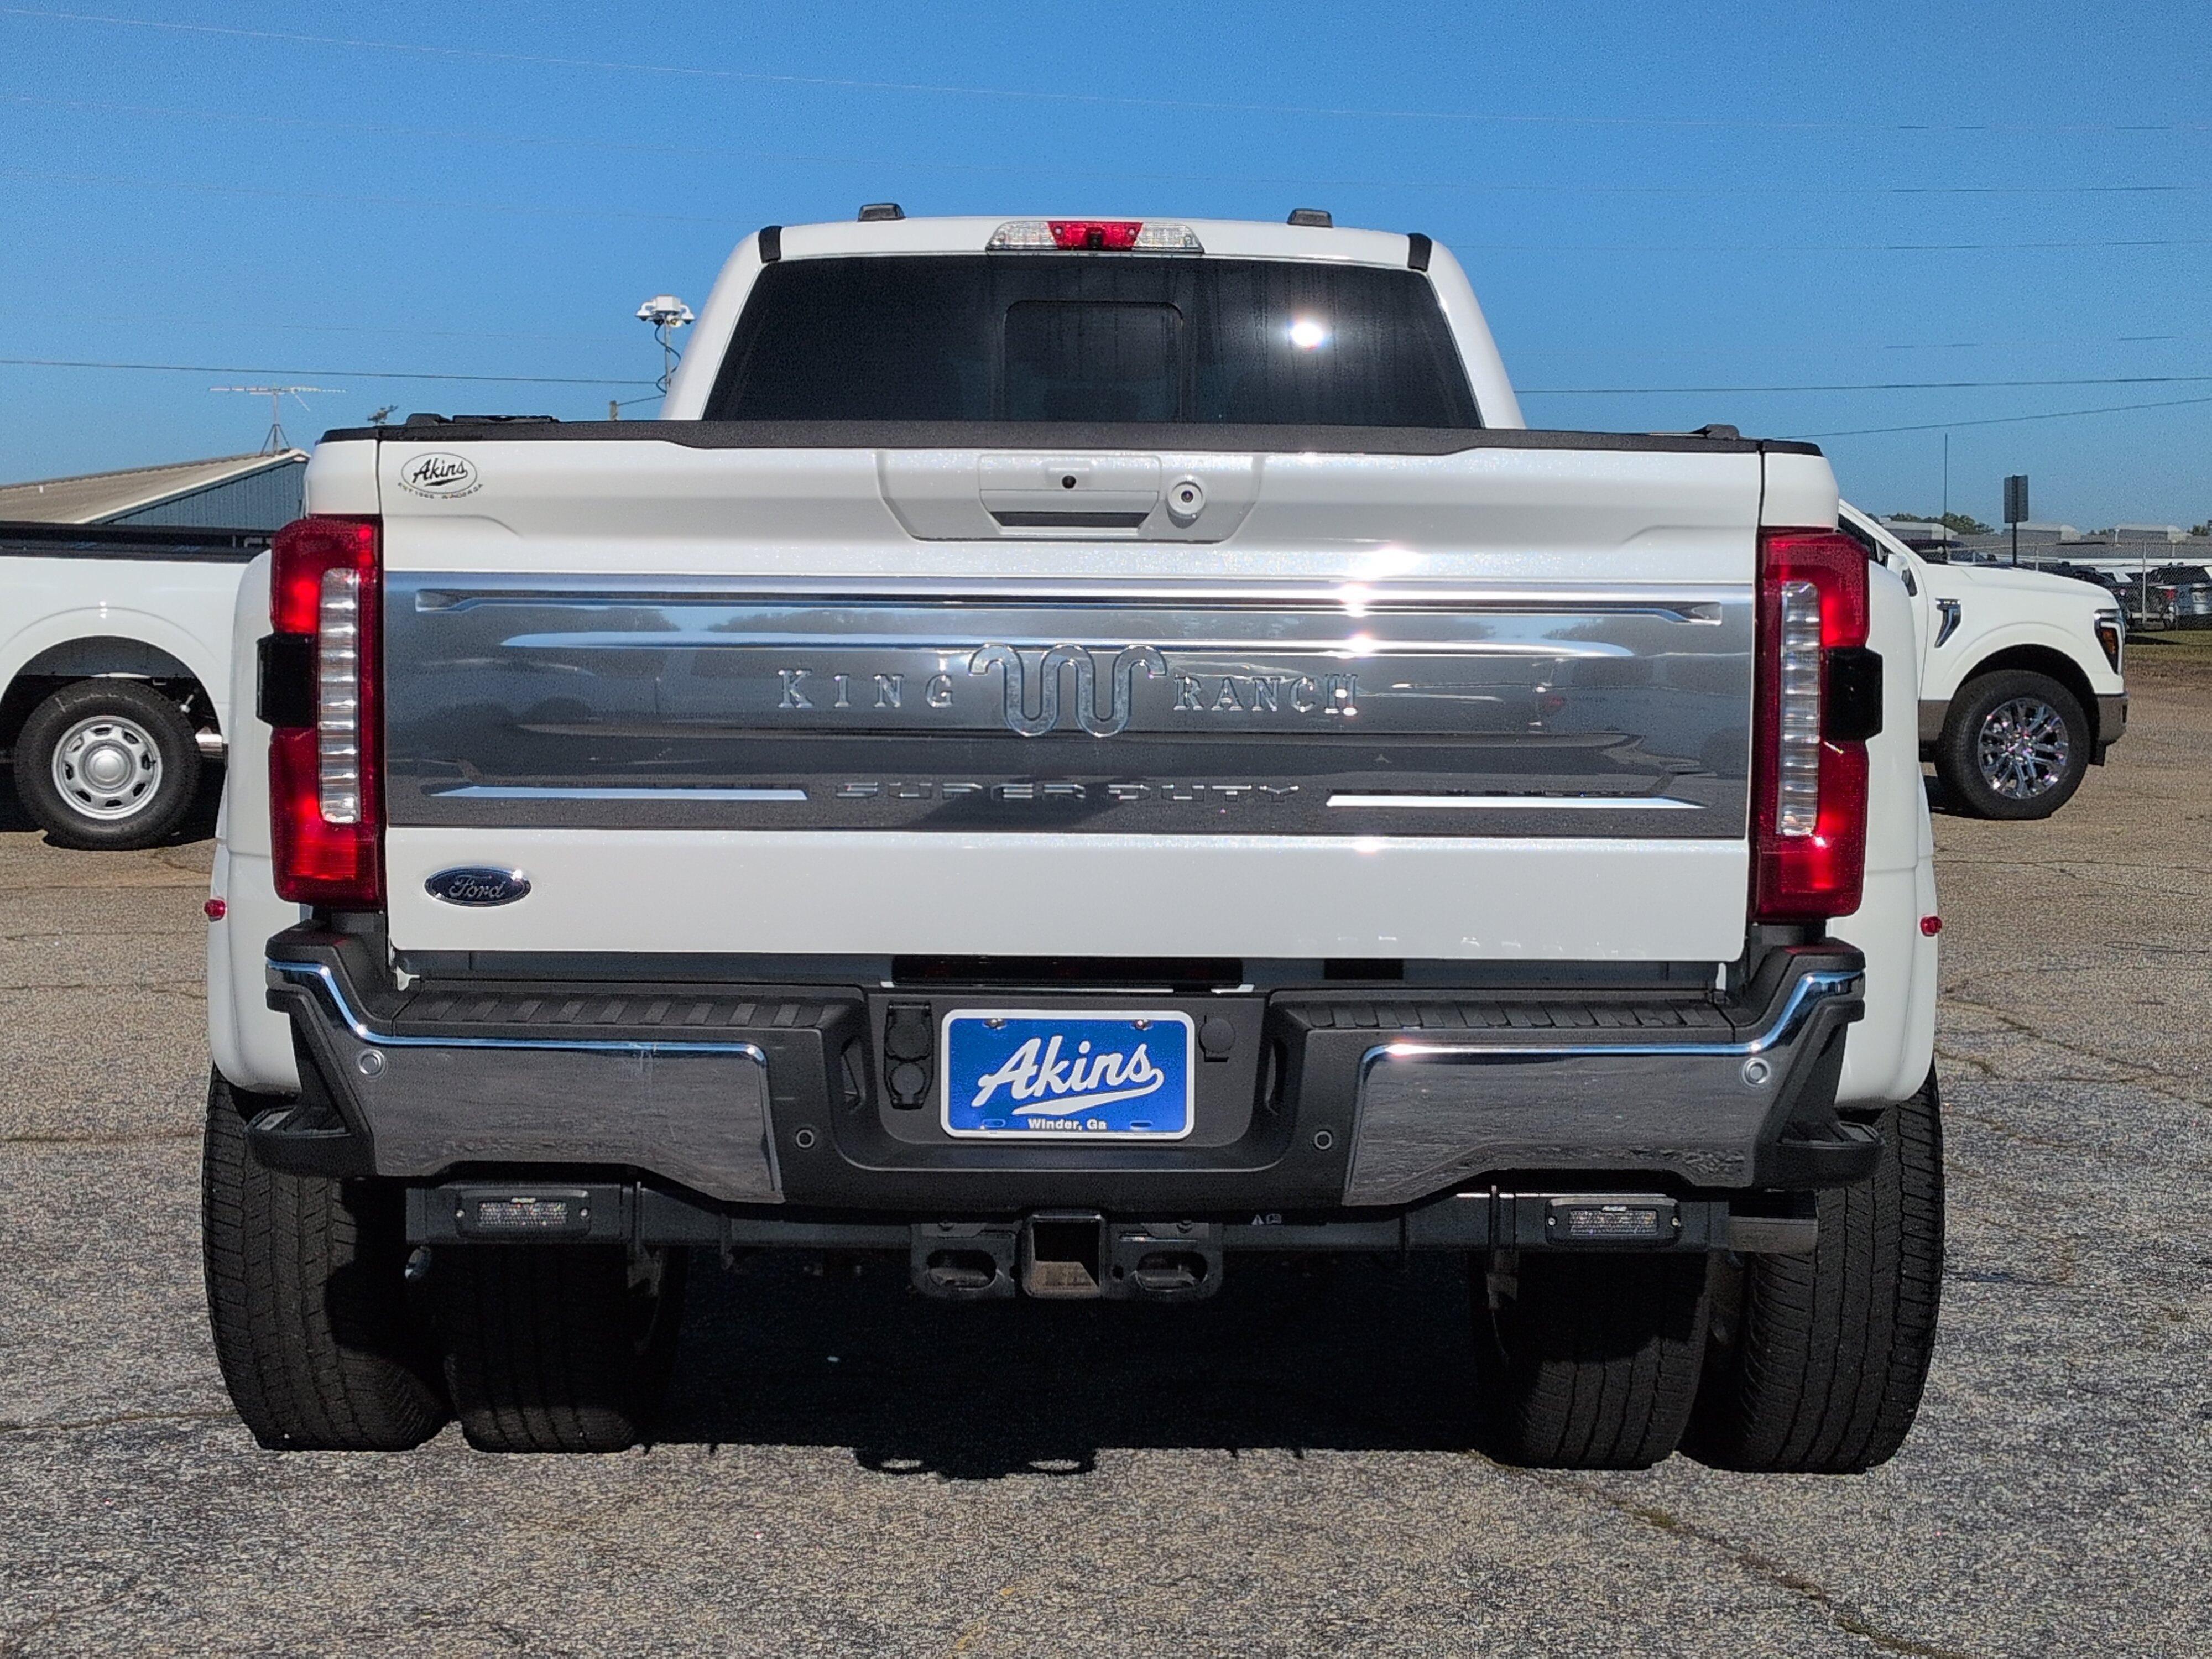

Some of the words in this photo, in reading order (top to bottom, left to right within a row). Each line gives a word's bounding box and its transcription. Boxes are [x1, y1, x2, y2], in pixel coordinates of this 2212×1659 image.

[412, 458, 468, 486] Akins
[776, 668, 954, 709] KING
[1173, 668, 1358, 716] RANCH
[836, 781, 1086, 800] SUPER
[1107, 783, 1300, 803] DUTY
[449, 874, 506, 898] Ford
[972, 1035, 1164, 1115] Akins
[1028, 1118, 1083, 1131] Winder,
[1087, 1119, 1107, 1130] Ga
